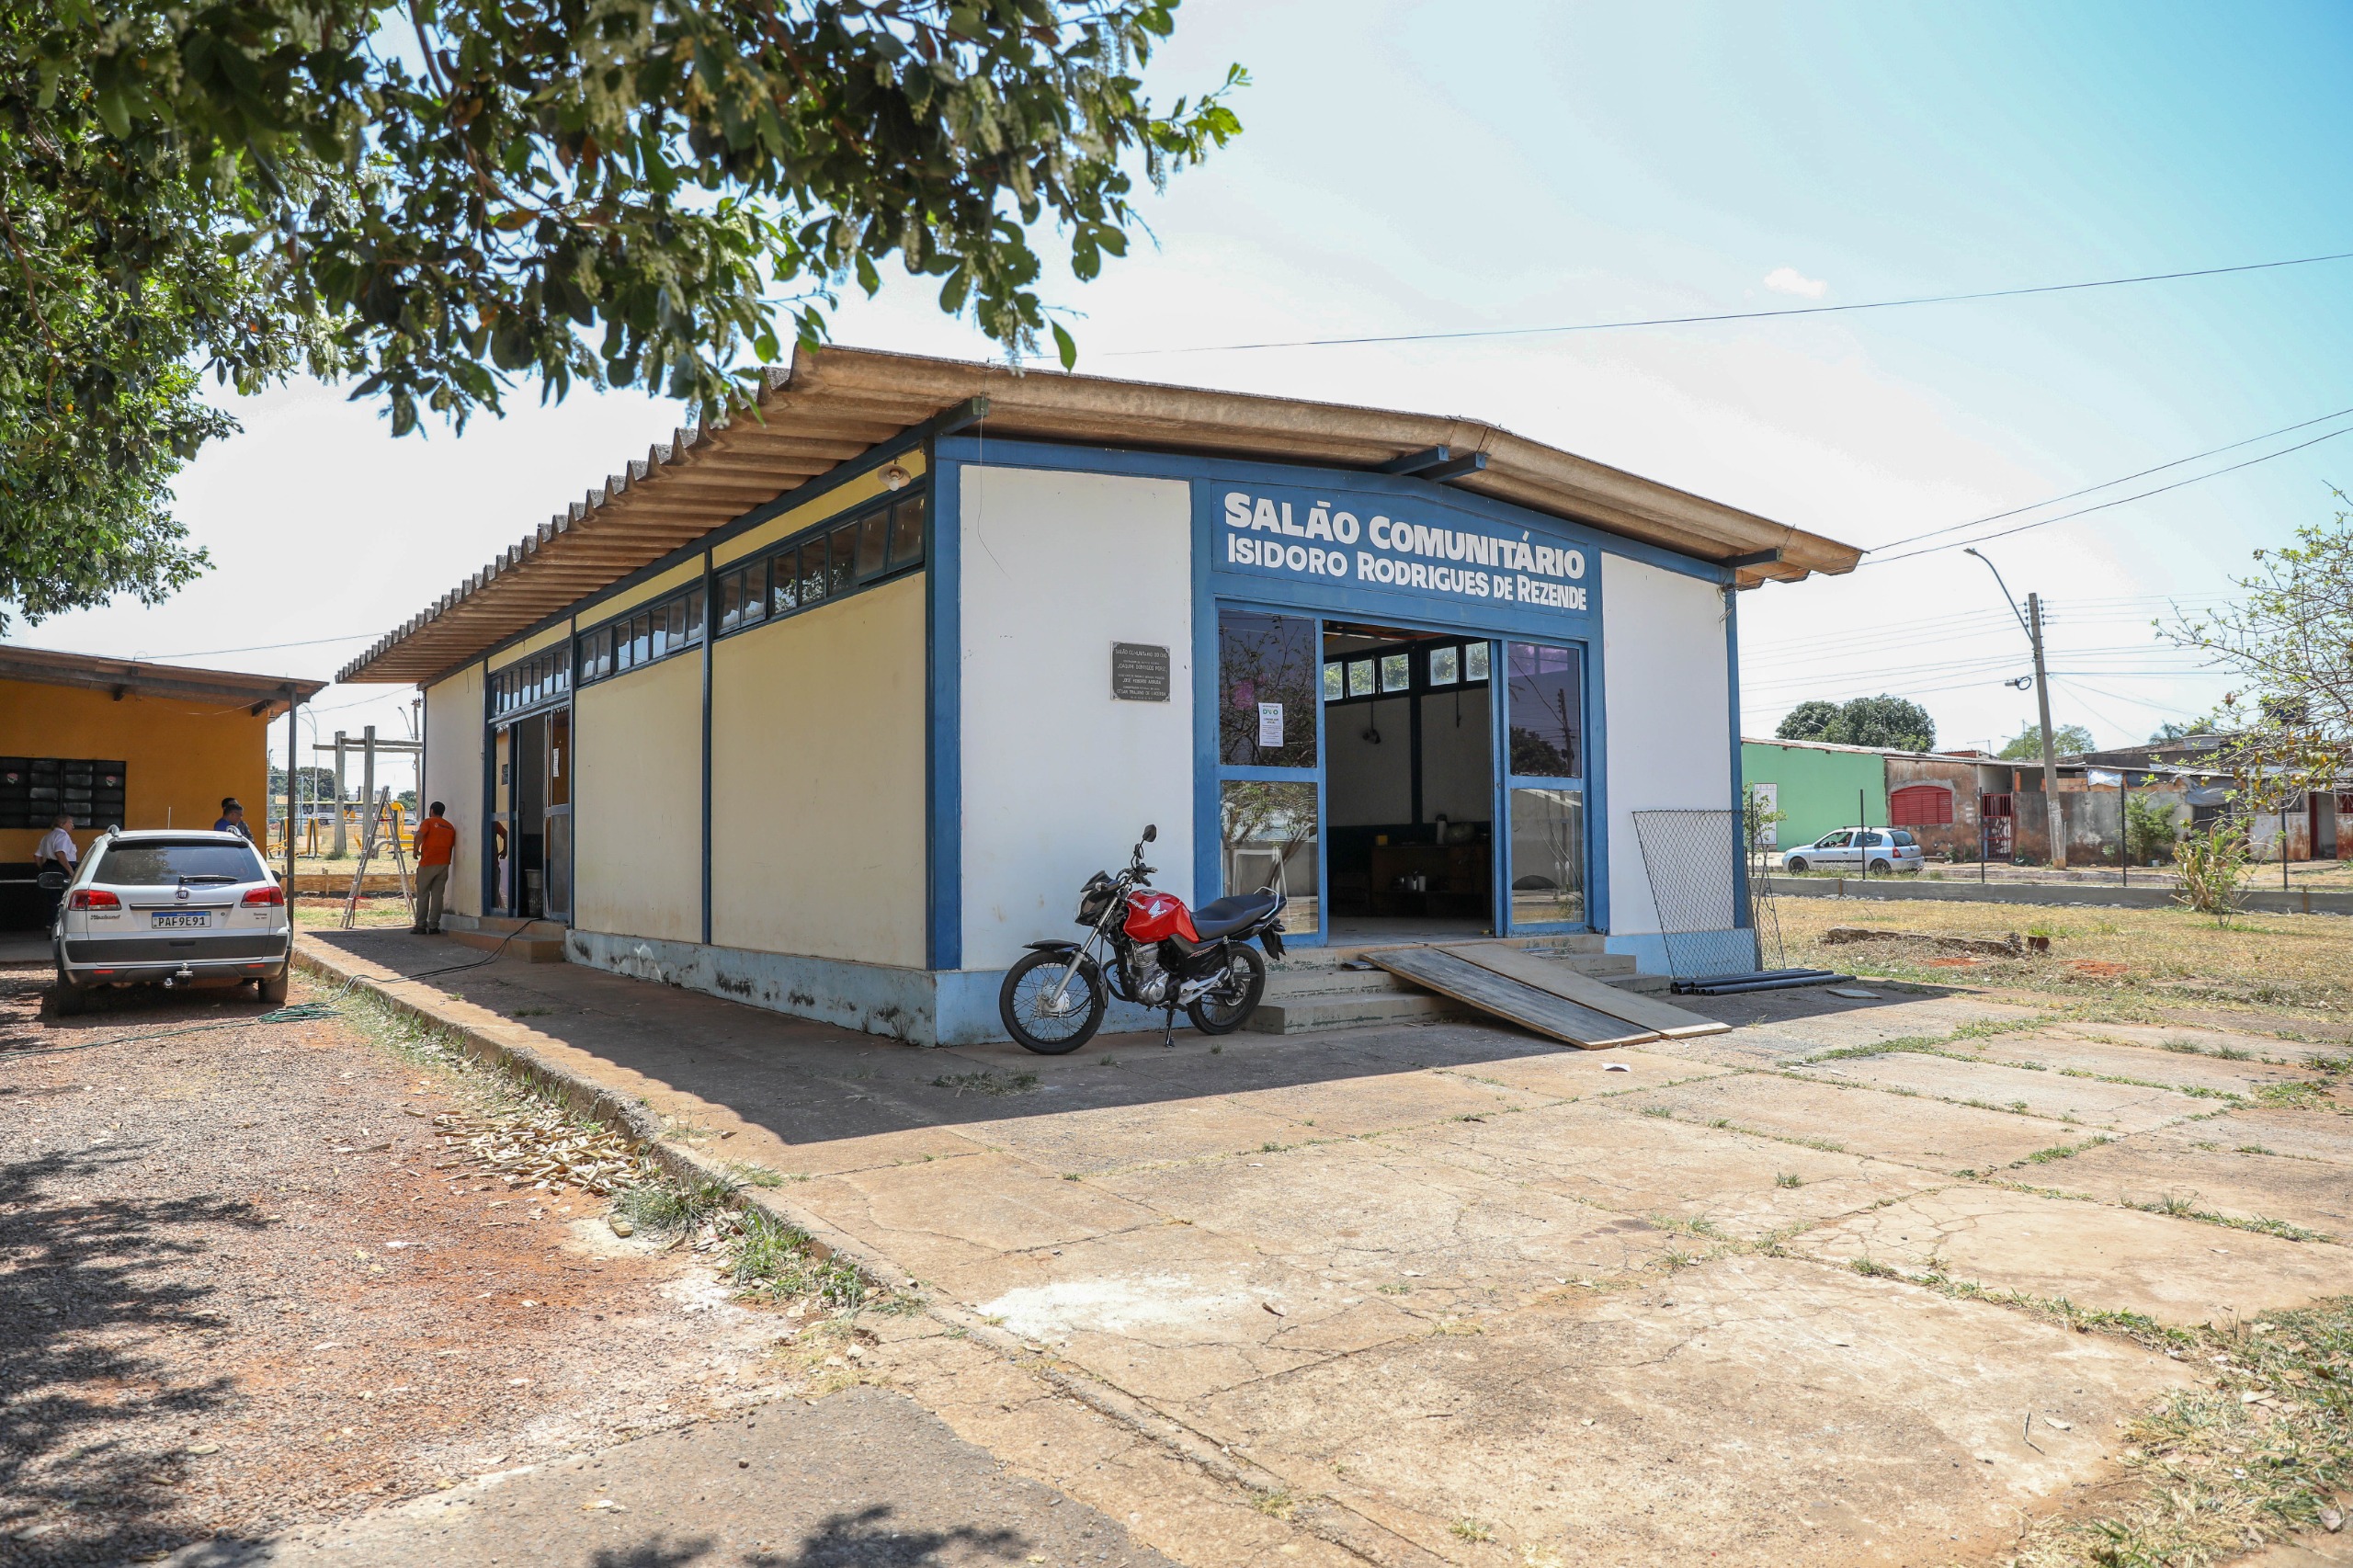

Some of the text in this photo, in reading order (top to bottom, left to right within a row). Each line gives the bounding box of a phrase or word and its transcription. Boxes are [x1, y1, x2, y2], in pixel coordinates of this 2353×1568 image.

[1224, 492, 1586, 579] SALÃO COMUNITÁRIO
[1228, 533, 1586, 611] ISIDORO RODRIGUES DE REZENDE
[158, 916, 205, 926] PAF9E91
